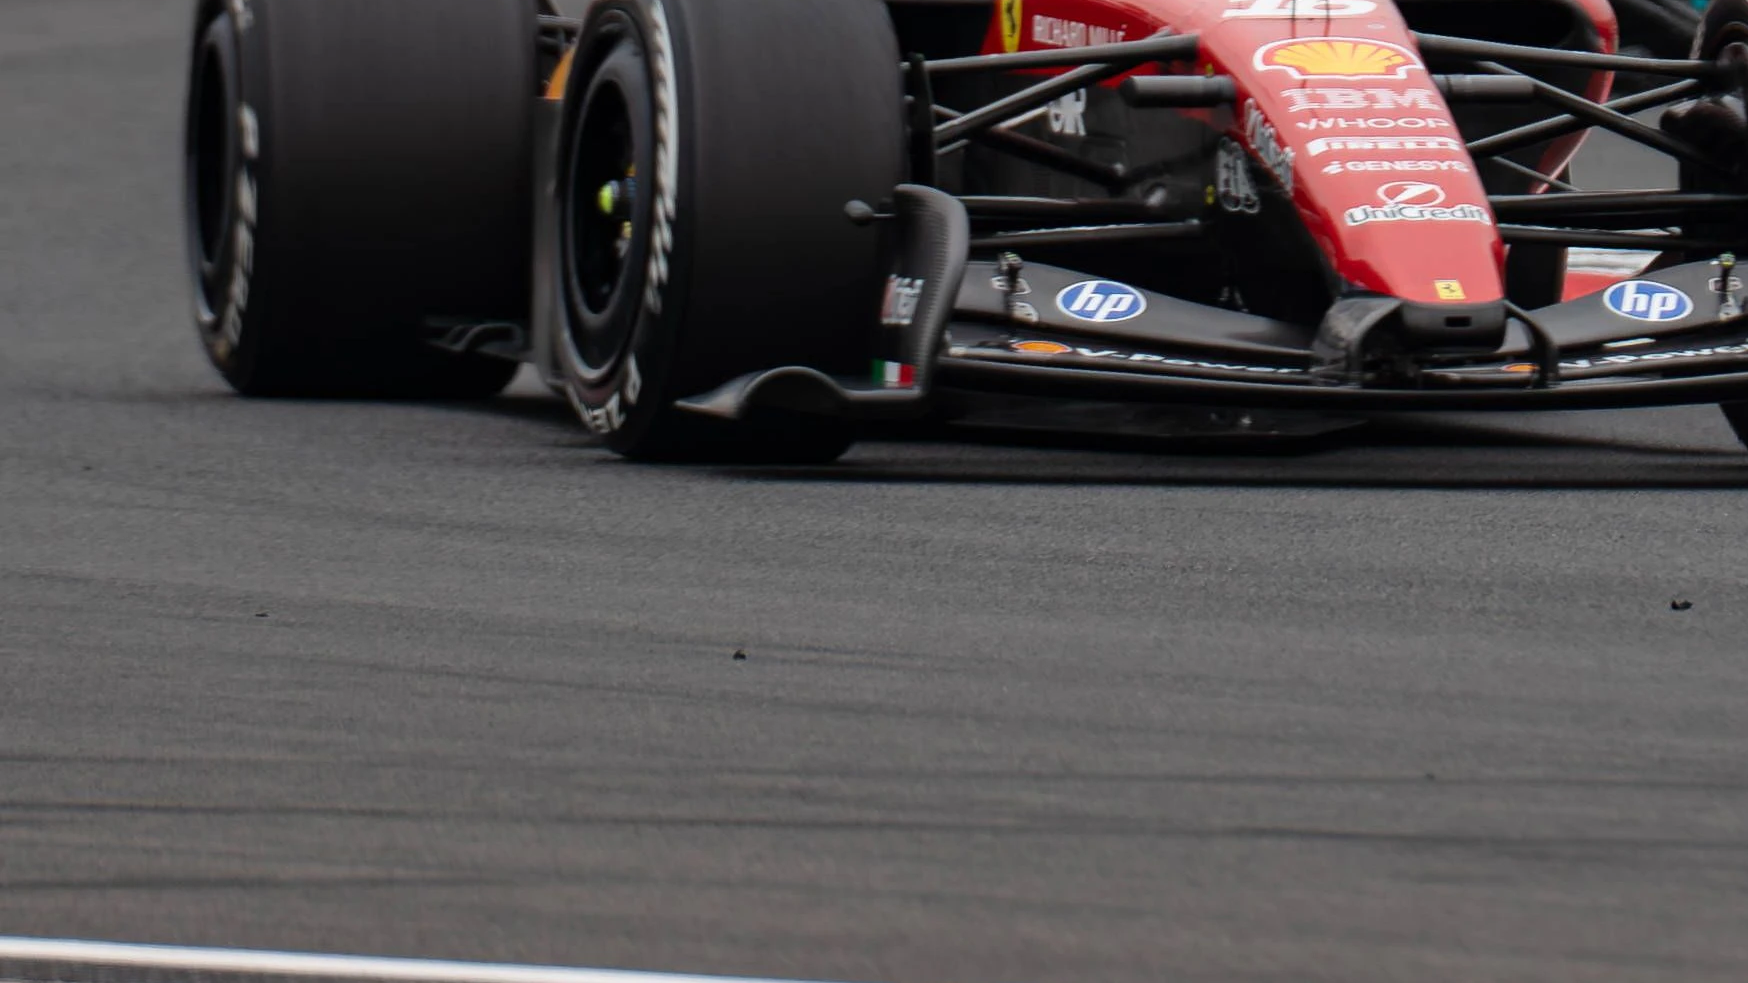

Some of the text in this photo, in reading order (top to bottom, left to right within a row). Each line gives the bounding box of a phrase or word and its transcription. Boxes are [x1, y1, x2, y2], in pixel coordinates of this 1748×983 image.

[1280, 87, 1443, 113] IBM
[1295, 117, 1451, 131] WHOOP
[1305, 135, 1463, 158] PIRELLI
[1345, 159, 1470, 173] GENESYS
[1347, 201, 1494, 227] UniCredit
[1071, 280, 1136, 322] hp
[1620, 280, 1678, 322] hp
